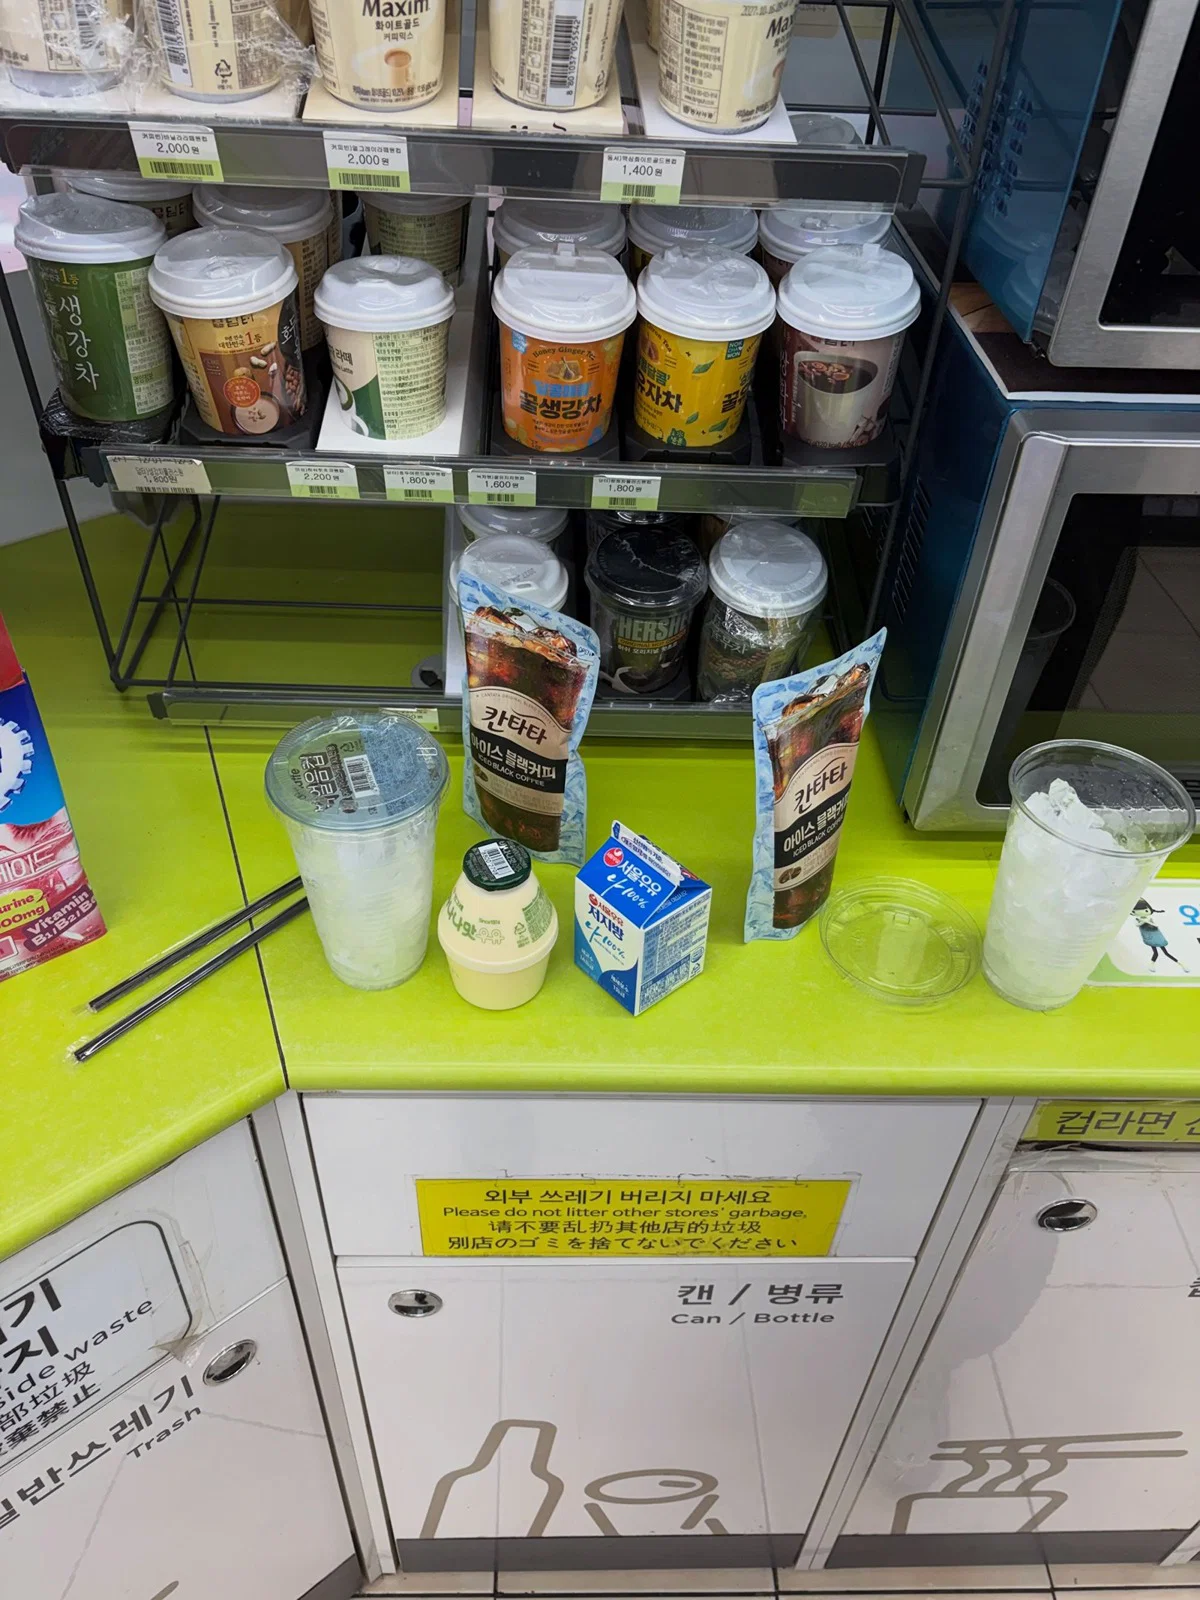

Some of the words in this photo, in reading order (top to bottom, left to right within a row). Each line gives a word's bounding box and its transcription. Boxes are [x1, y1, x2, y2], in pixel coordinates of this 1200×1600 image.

[375, 18, 420, 31] 화이트골드
[384, 32, 414, 42] 커피믹스
[59, 295, 99, 391] 생강차
[532, 347, 556, 358] Honey
[558, 346, 585, 354] Ginger
[519, 391, 602, 420] 꿀생강차
[481, 705, 548, 745] 칸타타
[471, 731, 504, 761] 아이스
[505, 749, 557, 779] 블랙커피
[478, 753, 492, 768] ICED
[492, 762, 514, 778] BLACK
[515, 772, 545, 787] COFFEE
[793, 760, 848, 815] 칸타타
[783, 821, 816, 852] 아이스
[806, 831, 827, 848] BLACK
[618, 860, 662, 897] 서울우유
[27, 890, 89, 935] Vitamin
[588, 903, 625, 941] 저지방
[1056, 1110, 1177, 1136] 컵라면
[484, 1189, 533, 1204] 외부
[539, 1189, 612, 1205] 쓰레기
[620, 1189, 692, 1205] 버리지
[699, 1190, 772, 1205] 마세요
[443, 1207, 501, 1217] Please
[504, 1207, 528, 1217] do
[531, 1208, 563, 1217] not
[566, 1207, 609, 1217] litter
[612, 1208, 661, 1217] other
[664, 1207, 725, 1218] stores'
[488, 1220, 762, 1234] 请不要乱扔其他店的垃圾
[448, 1236, 798, 1250] 別店のゴミを捨てないでください
[677, 1284, 715, 1306] 캔
[728, 1283, 752, 1306] /
[767, 1283, 844, 1305] 병류
[63, 1299, 153, 1362] waste
[671, 1313, 721, 1324] Can
[728, 1312, 746, 1325] /
[753, 1312, 835, 1324] Bottle
[0, 1380, 101, 1457] 棄禁止
[126, 1405, 202, 1459] Trash
